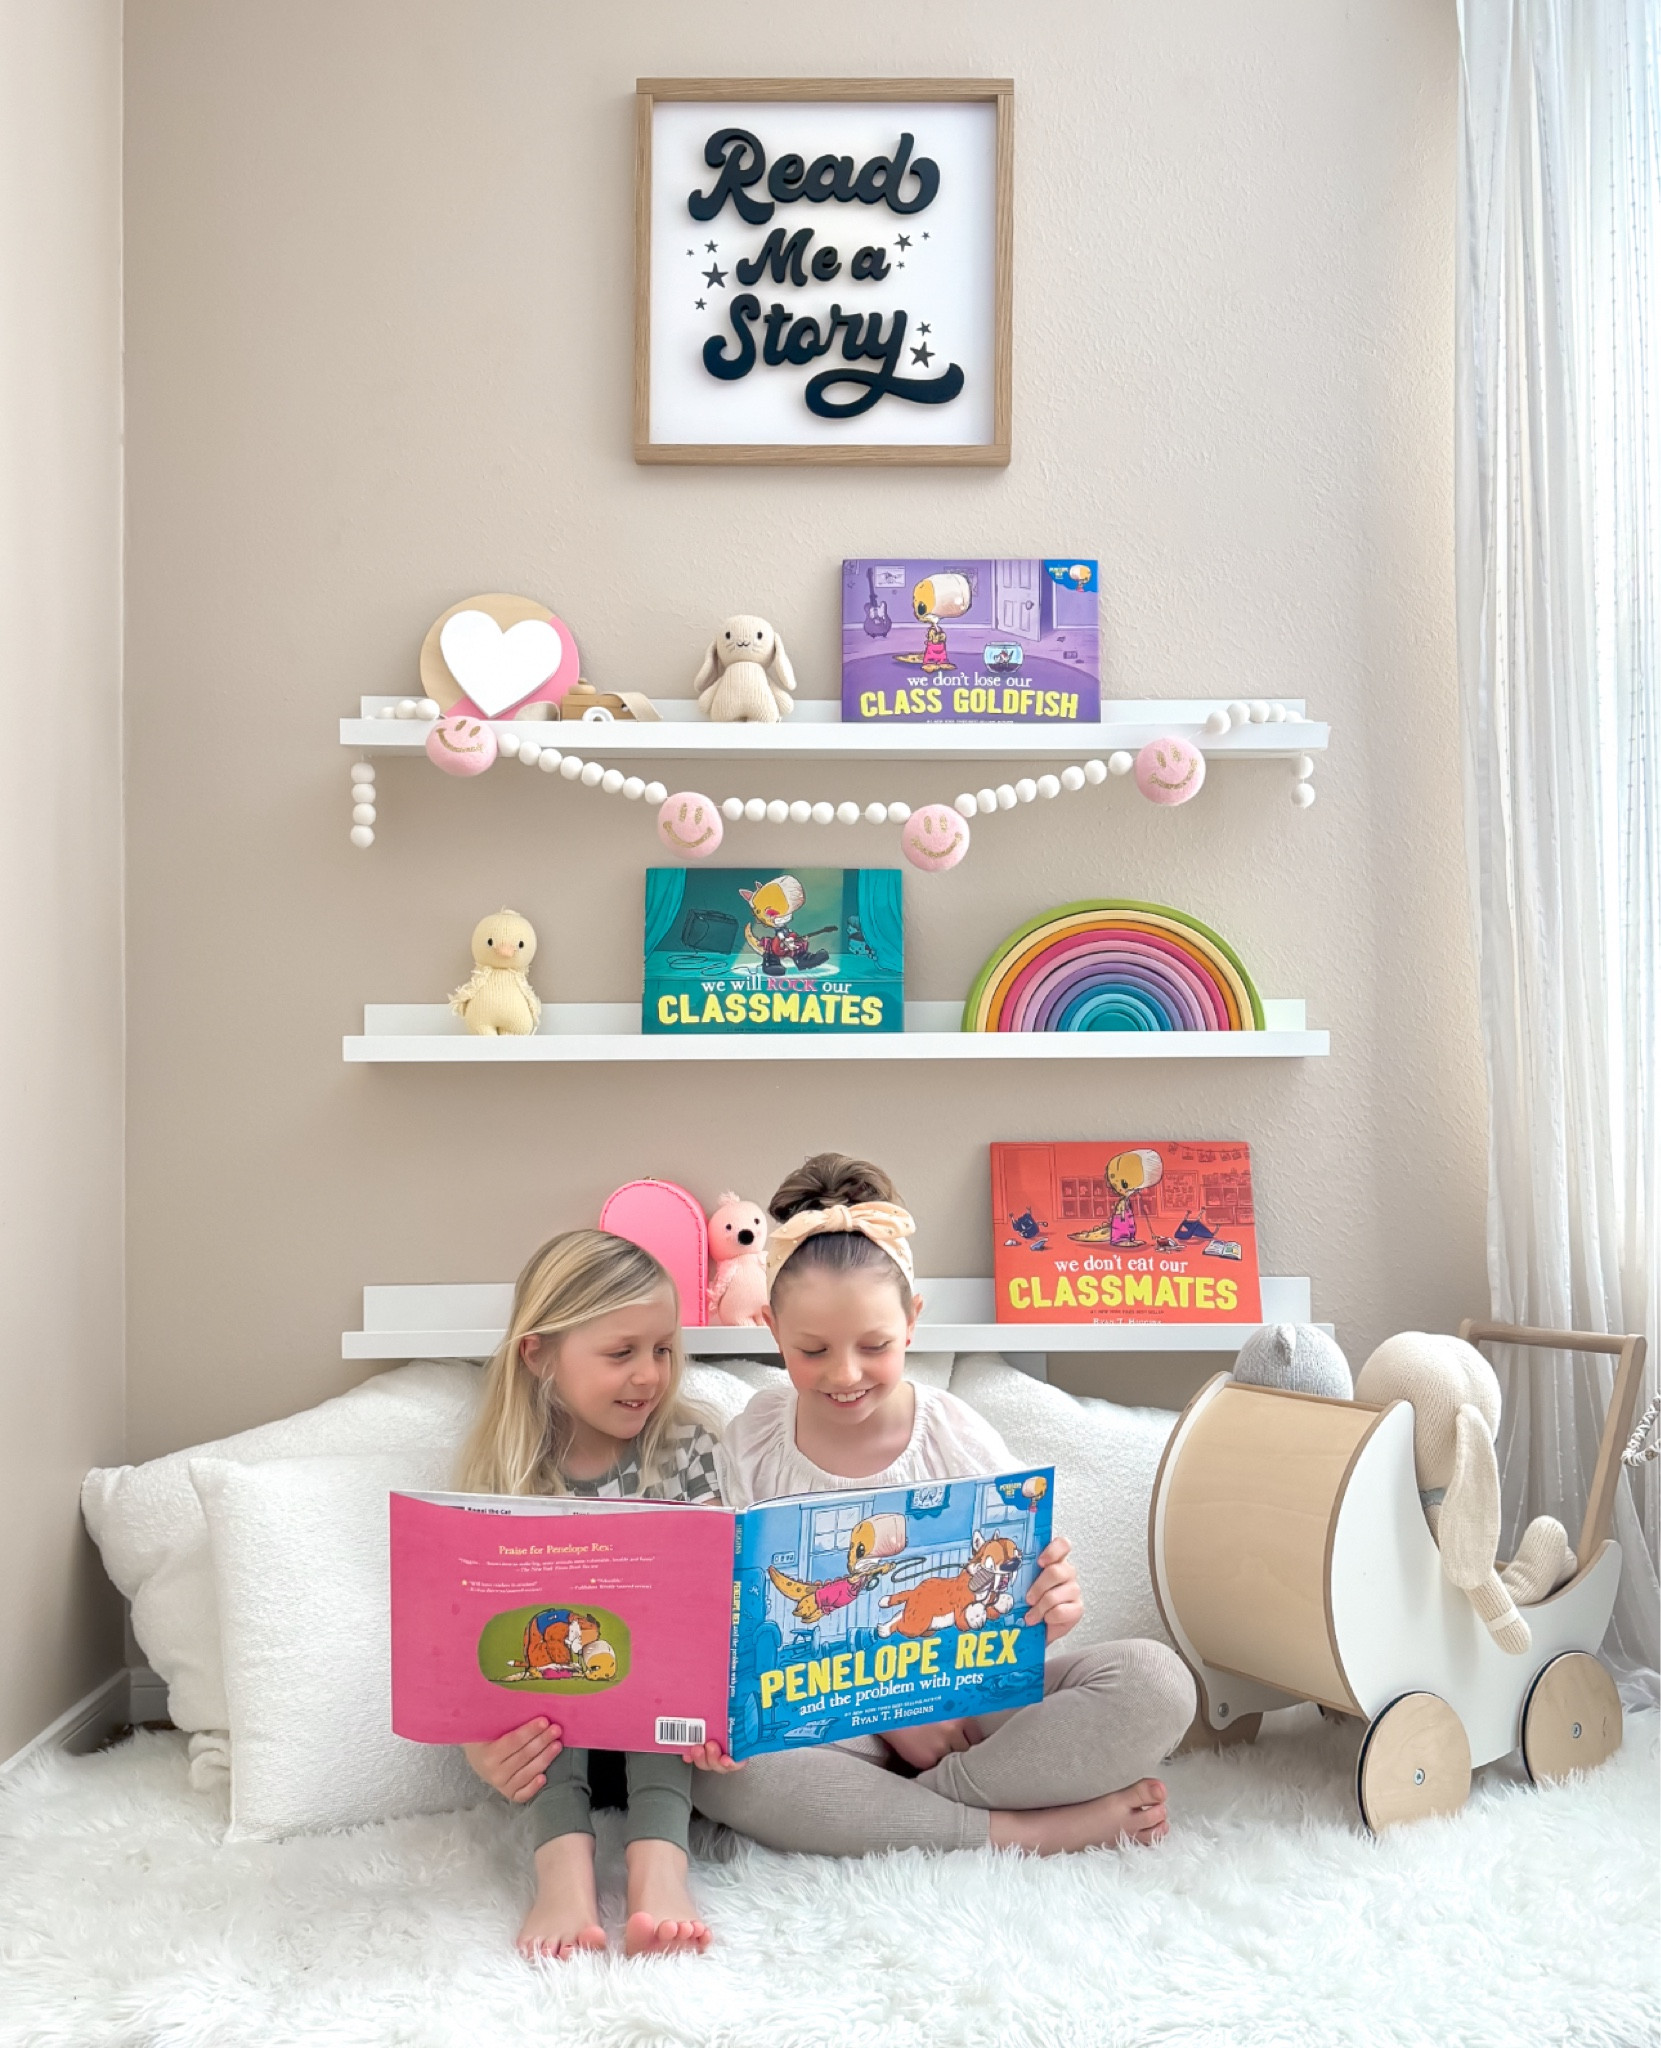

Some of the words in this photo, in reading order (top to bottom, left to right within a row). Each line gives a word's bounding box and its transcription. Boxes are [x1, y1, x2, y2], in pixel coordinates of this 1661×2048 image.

[688, 128, 940, 224] Read
[736, 228, 842, 286] Me
[851, 246, 891, 281] a
[703, 293, 965, 418] Story
[907, 675, 928, 686] we
[933, 672, 969, 686] don't
[974, 672, 1001, 686] lose
[1006, 677, 1032, 687] our
[860, 689, 942, 718] CLASS
[954, 689, 1079, 719] GOLDFISH
[701, 980, 725, 992] we
[730, 975, 762, 991] will
[767, 978, 818, 992] ROCK
[822, 982, 852, 993] our
[657, 993, 883, 1026] CLASSMATES
[1054, 1259, 1079, 1273] we
[1084, 1255, 1122, 1271] don't
[1128, 1258, 1154, 1271] eat
[1160, 1260, 1188, 1273] our
[1009, 1274, 1238, 1310] CLASSMATES
[499, 1545, 528, 1555] Praise
[529, 1545, 543, 1555] for
[546, 1543, 588, 1556] Penelope
[591, 1543, 614, 1552] Rex:
[760, 1638, 942, 1708] PENELOPE
[956, 1628, 1020, 1669] REX
[799, 1695, 825, 1716] and
[829, 1693, 851, 1708] the
[855, 1680, 914, 1706] problem
[920, 1672, 950, 1690] with
[954, 1672, 984, 1693] pets
[852, 1715, 878, 1727] RYAN
[881, 1711, 891, 1721] T.
[894, 1706, 934, 1719] HIGGINS
